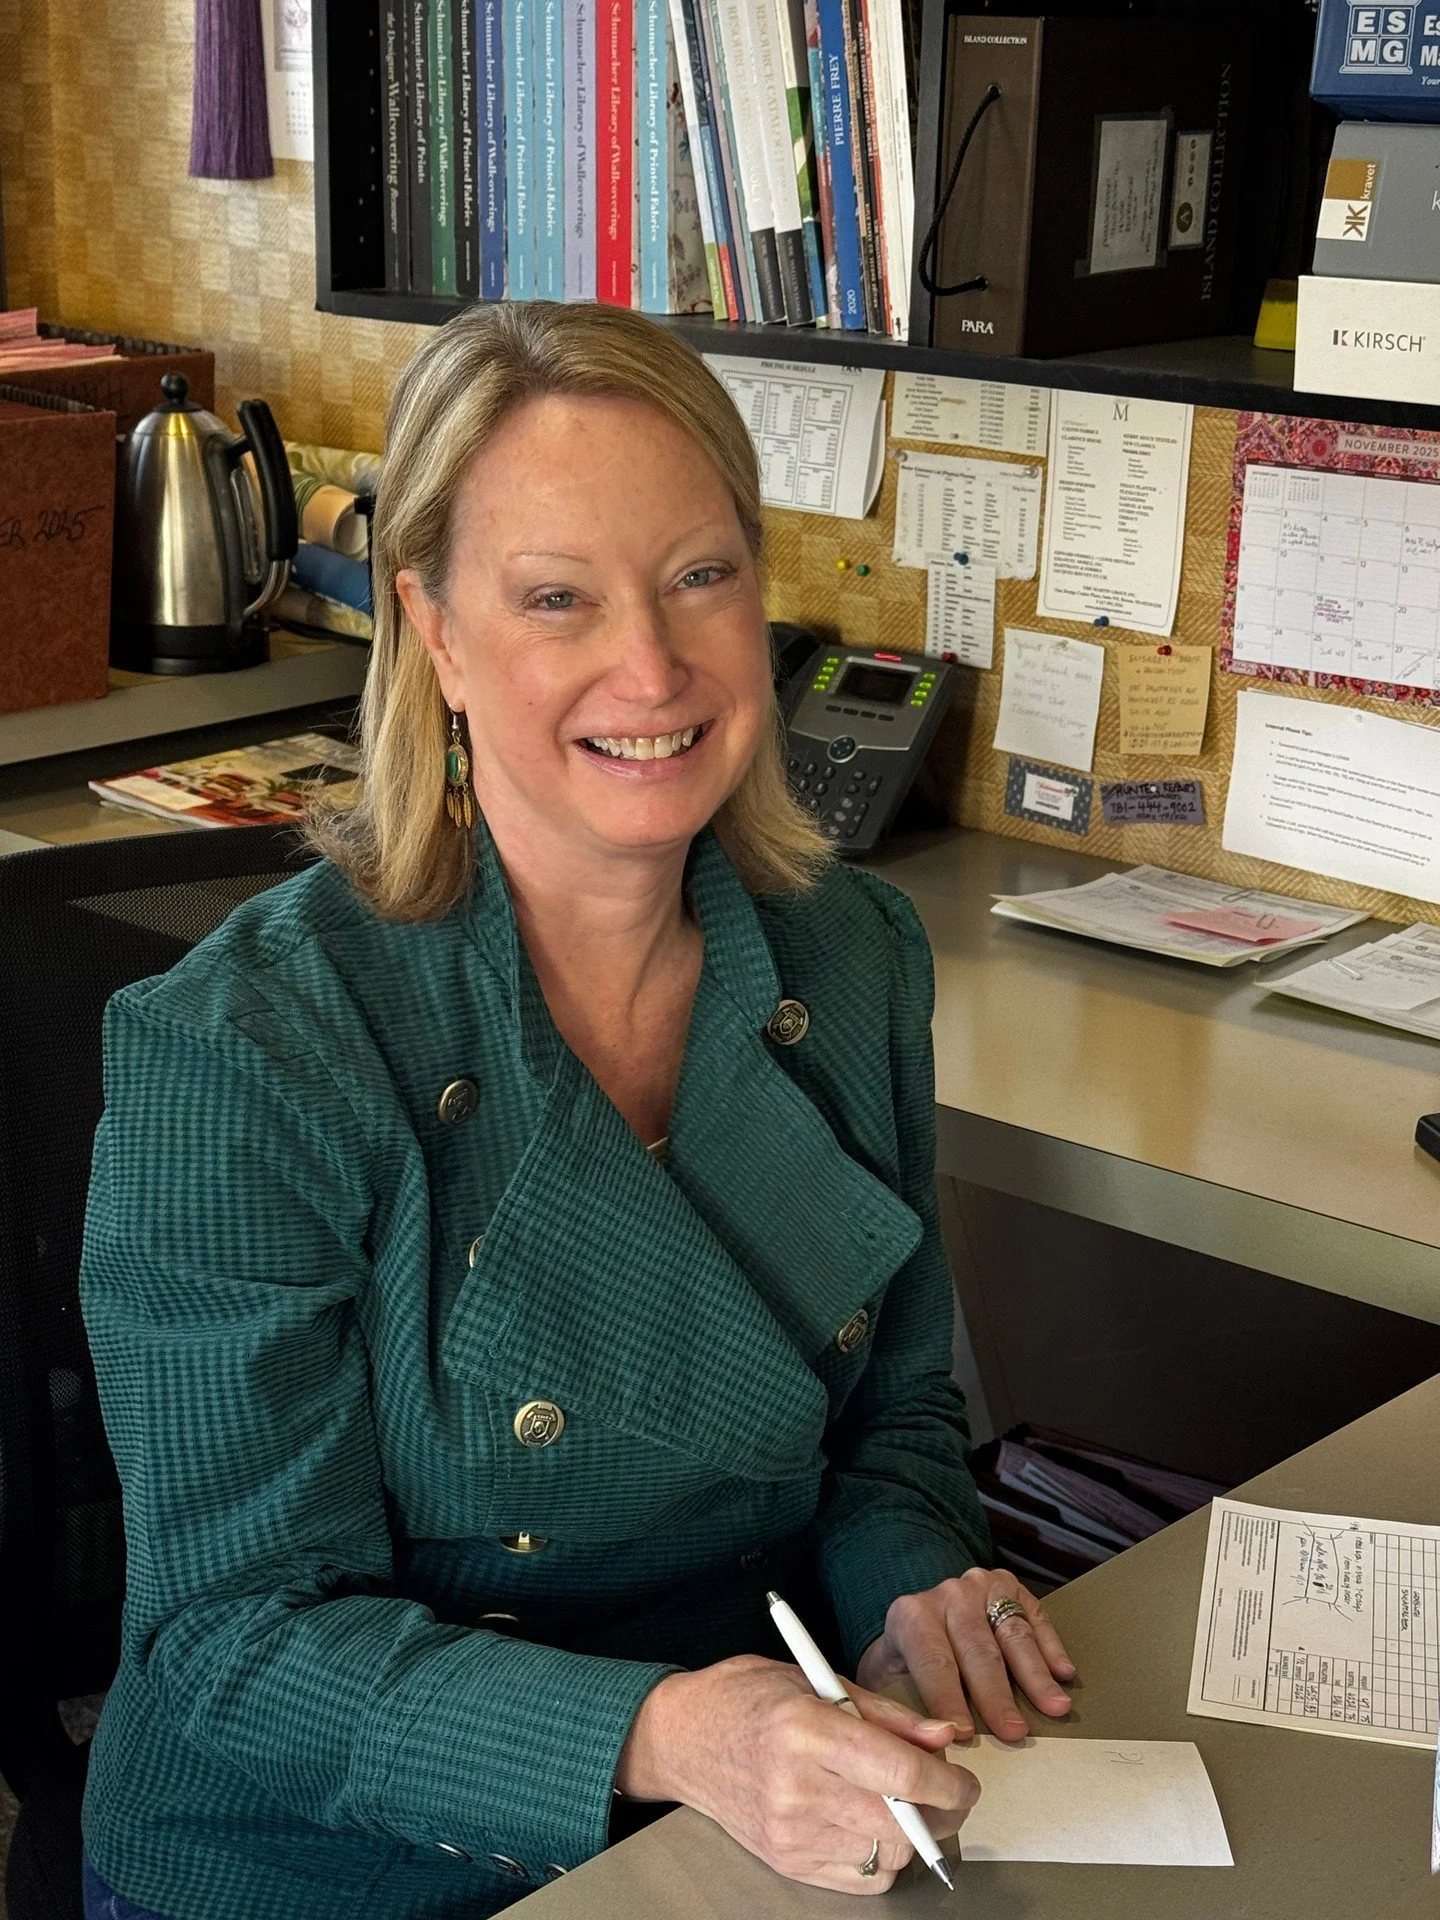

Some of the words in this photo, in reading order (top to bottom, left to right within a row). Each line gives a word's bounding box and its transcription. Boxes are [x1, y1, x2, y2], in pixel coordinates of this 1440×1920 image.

[414, 2, 424, 80] Schumacher
[436, 0, 446, 77] Schumacher
[485, 2, 495, 81] Schumacher
[515, 2, 524, 78] Schumacher
[545, 2, 555, 80] Schumacher
[576, 3, 586, 84] Schumacher
[611, 2, 621, 84] Schumacher
[648, 0, 658, 80] Schumacher
[987, 35, 1027, 45] COLLECTION
[829, 54, 841, 89] FREY
[413, 82, 425, 126] Library
[436, 80, 447, 124] Library
[460, 74, 471, 118] Library
[485, 84, 496, 129] Library
[514, 81, 525, 124] Library
[543, 82, 555, 126] Library
[574, 87, 586, 132] Library
[609, 86, 621, 133] Library
[647, 82, 659, 127] Library
[386, 81, 401, 185] Wallcovering
[416, 129, 426, 143] of
[439, 127, 448, 140] of
[463, 121, 472, 134] of
[487, 131, 496, 144] of
[517, 128, 525, 141] of
[546, 129, 555, 143] of
[650, 131, 659, 145] of
[832, 92, 844, 146] PIERRE
[1208, 63, 1231, 214] COLLECTION
[463, 137, 472, 182] Printed
[577, 136, 586, 149] of
[611, 136, 621, 150] of
[417, 146, 427, 183] Prints
[438, 141, 449, 227] Wallcoverings
[517, 145, 525, 189] Printed
[547, 146, 556, 191] Printed
[649, 148, 659, 195] Printed
[1359, 163, 1376, 200] kravet
[464, 184, 473, 226] Fabrics
[487, 145, 498, 233] Wallcoverings
[575, 151, 586, 238] Wallcoverings
[609, 151, 621, 240] Wallcoverings
[518, 192, 526, 235] Fabrics
[547, 194, 556, 237] Fabrics
[651, 198, 660, 241] Fabrics
[1201, 218, 1218, 300] ISLAND
[847, 289, 857, 315] 2020
[1113, 403, 1129, 421] M
[1344, 438, 1410, 455] NOVEMBER
[1412, 447, 1439, 459] 2025
[1363, 519, 1368, 527] 5
[1404, 524, 1409, 532] 6
[1279, 550, 1287, 558] 10
[1360, 560, 1367, 568] 12
[1357, 600, 1363, 608] 19
[1397, 606, 1407, 614] 20
[1274, 628, 1283, 636] 24
[1313, 634, 1322, 642] 25
[1354, 639, 1362, 647] 26
[1395, 645, 1403, 653] 27
[1285, 726, 1301, 734] Phone
